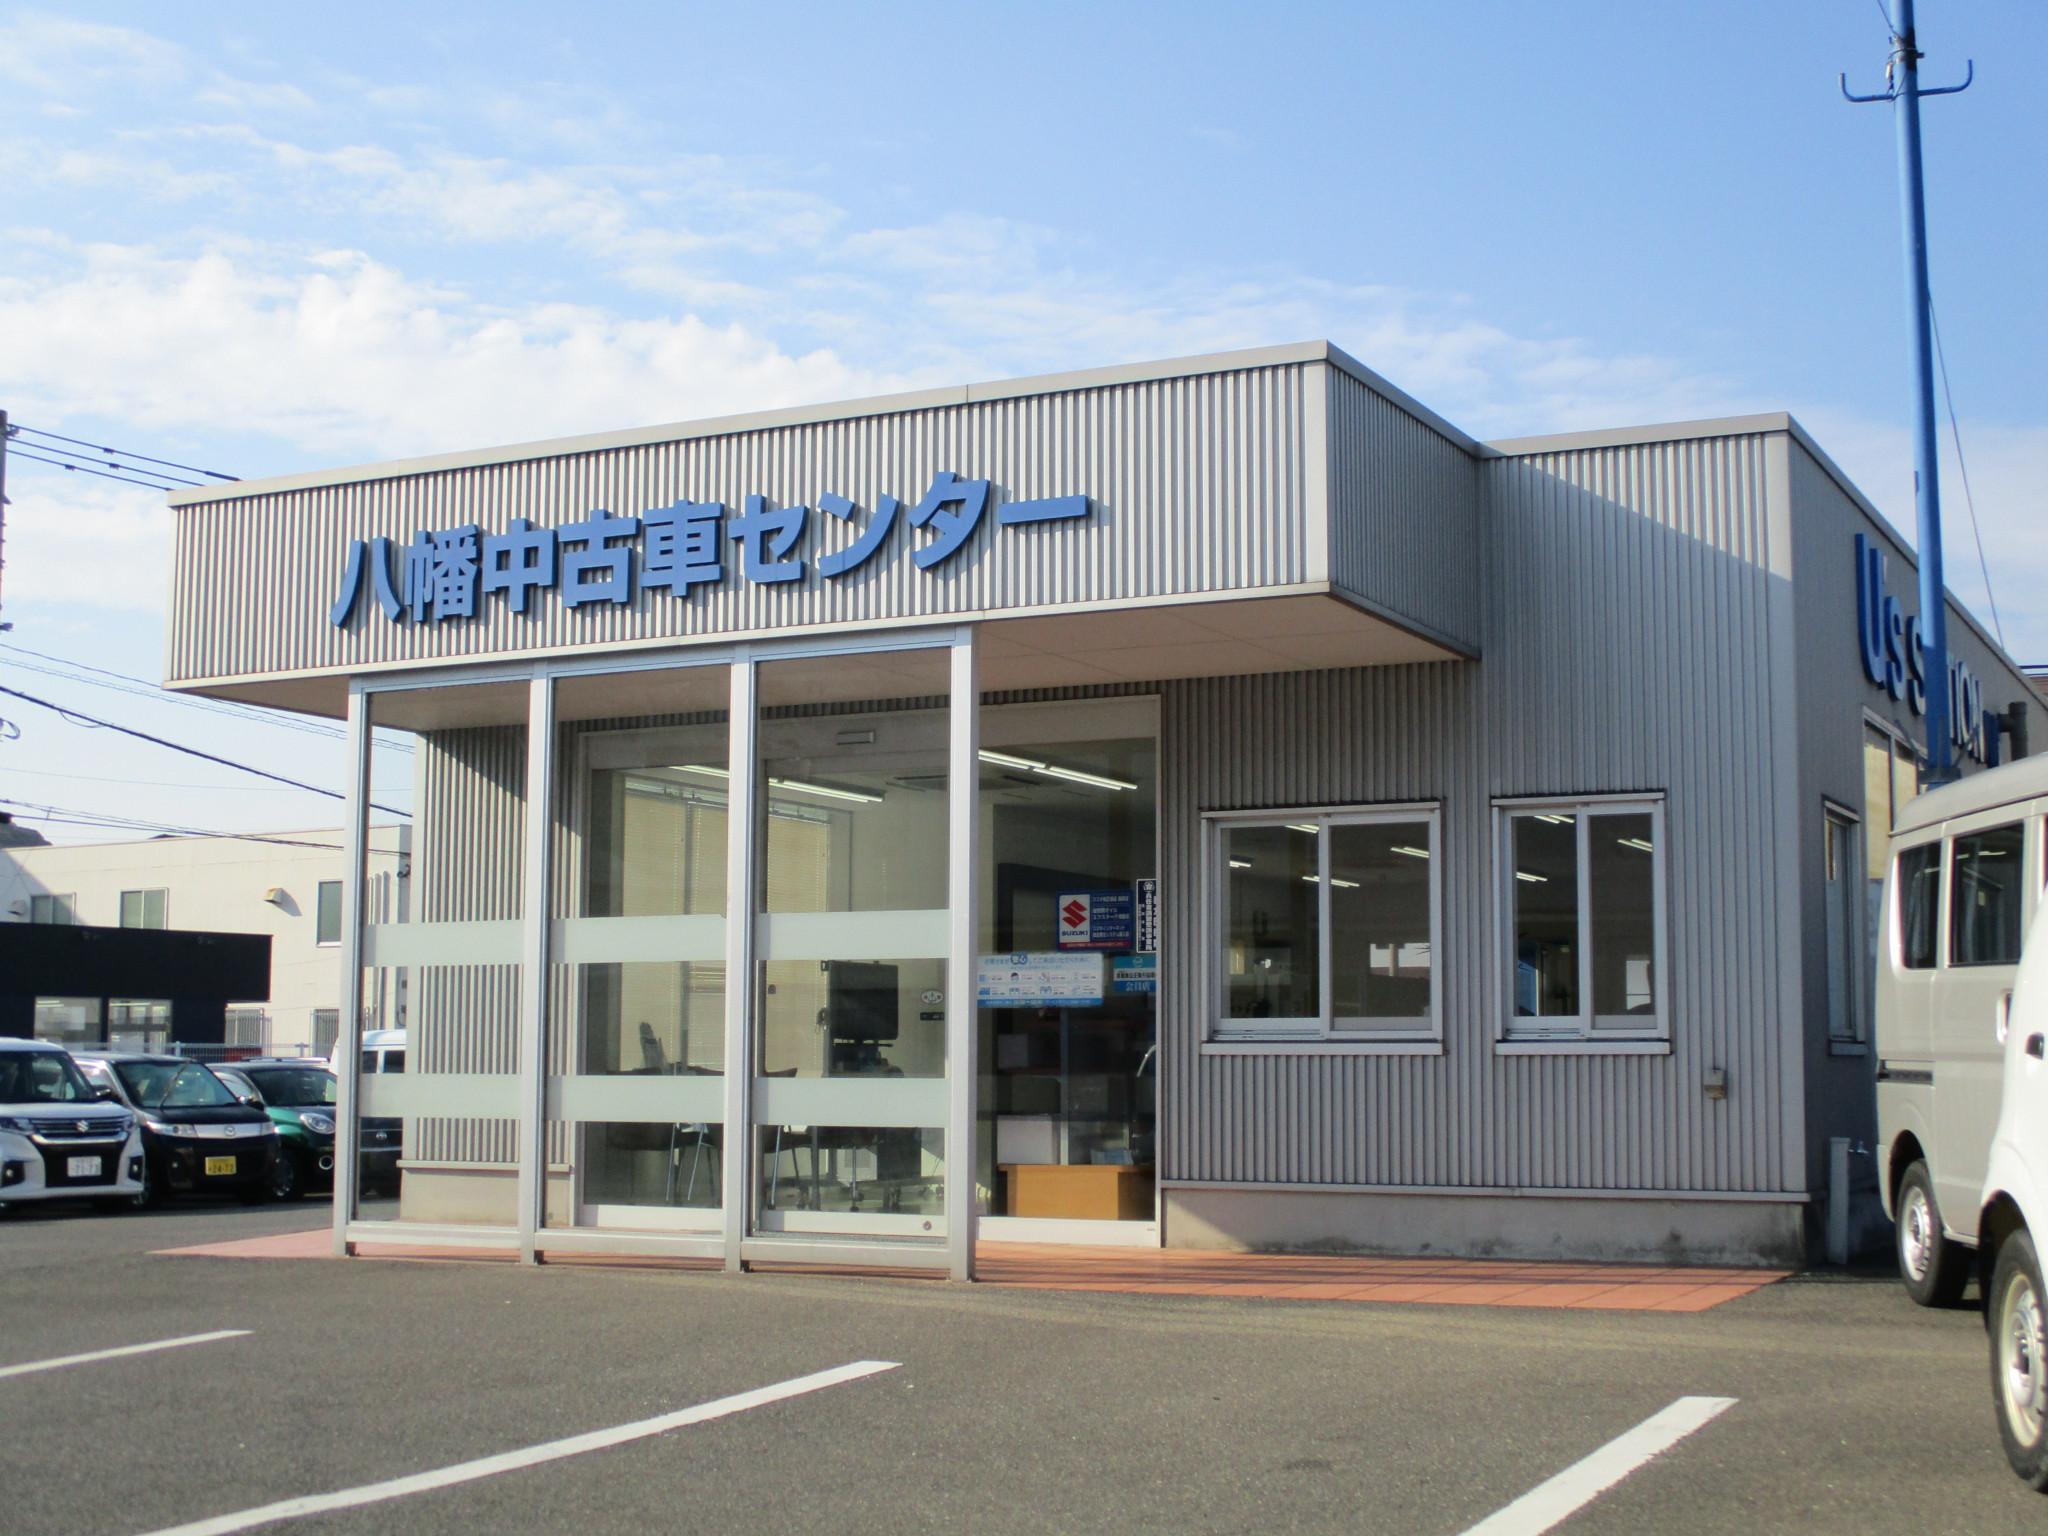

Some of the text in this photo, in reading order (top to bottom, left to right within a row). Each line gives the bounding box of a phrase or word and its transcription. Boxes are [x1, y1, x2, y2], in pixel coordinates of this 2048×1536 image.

[331, 471, 1089, 627] 八幡中古車センター
